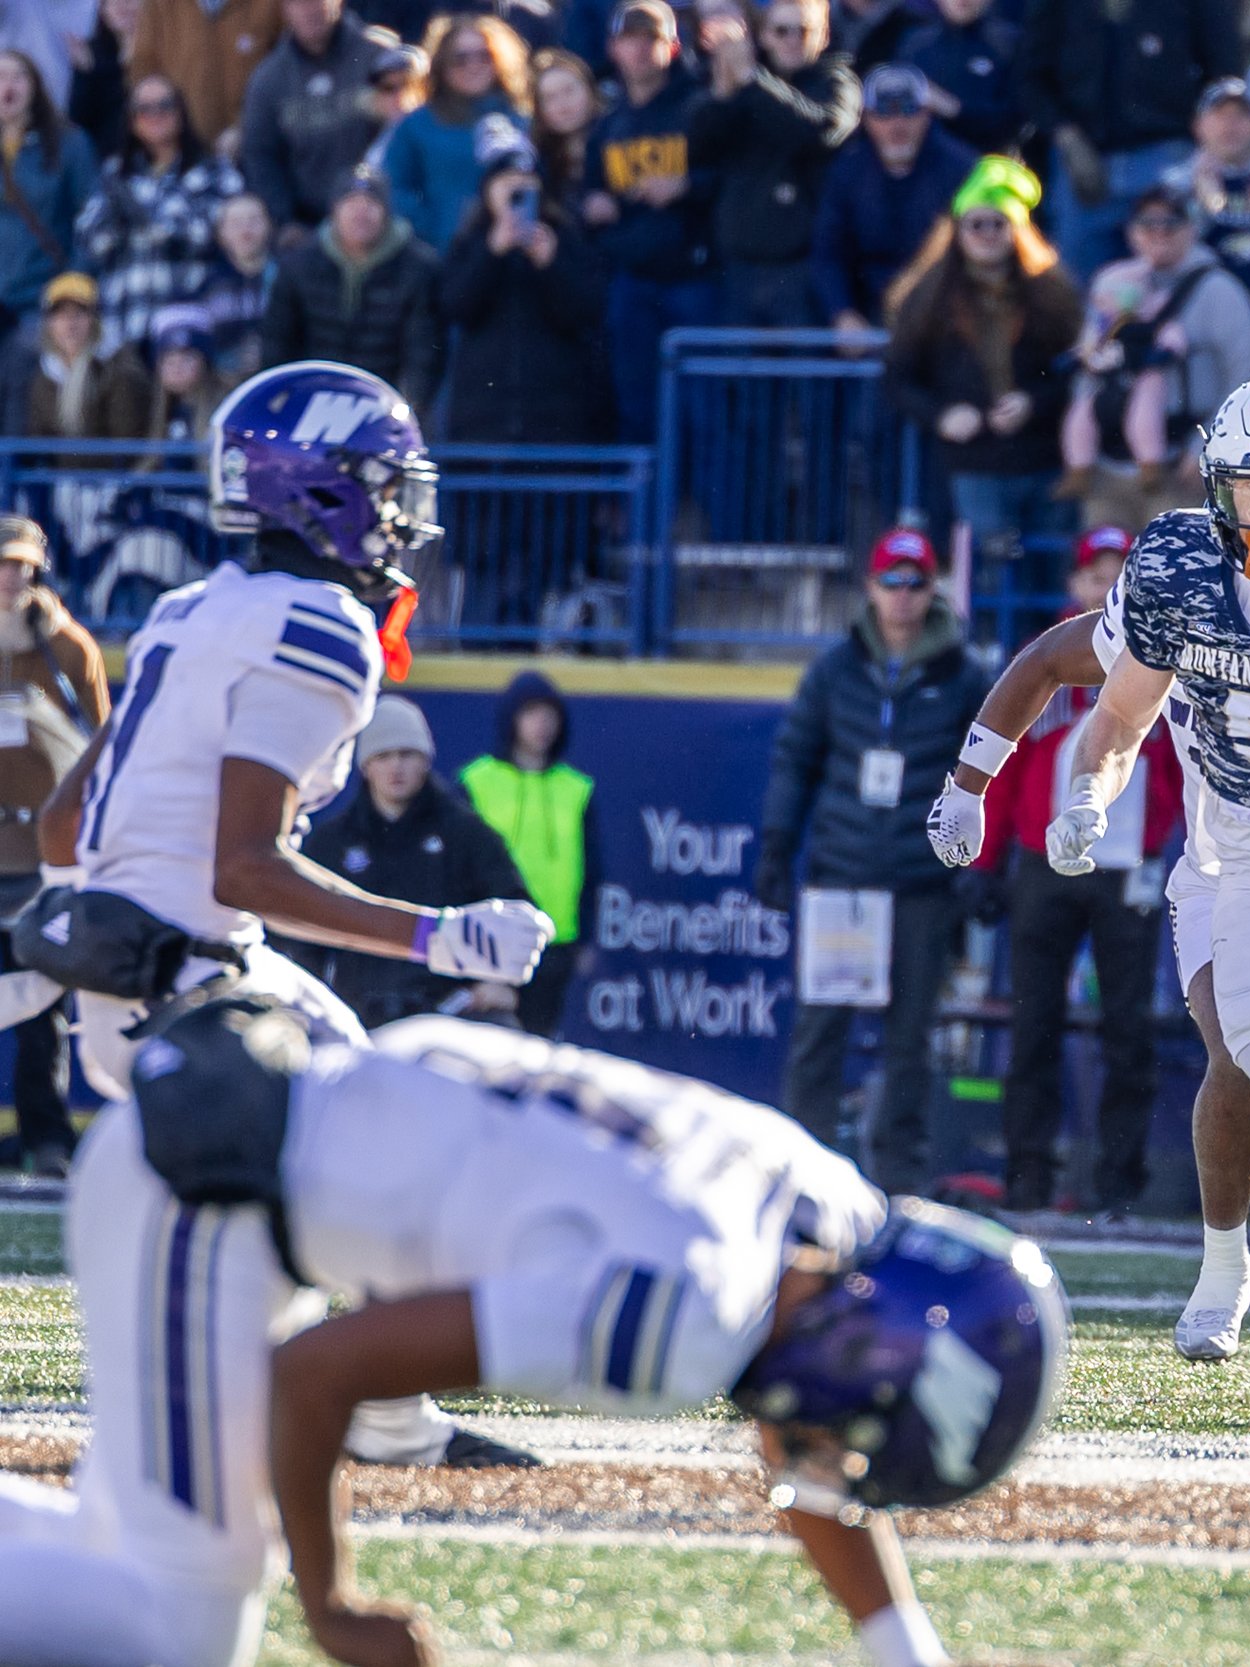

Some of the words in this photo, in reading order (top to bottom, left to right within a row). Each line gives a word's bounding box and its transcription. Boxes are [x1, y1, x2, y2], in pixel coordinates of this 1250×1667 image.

[642, 807, 754, 876] Your
[597, 884, 790, 959] Benefits
[588, 974, 643, 1032] at
[650, 968, 779, 1037] Work
